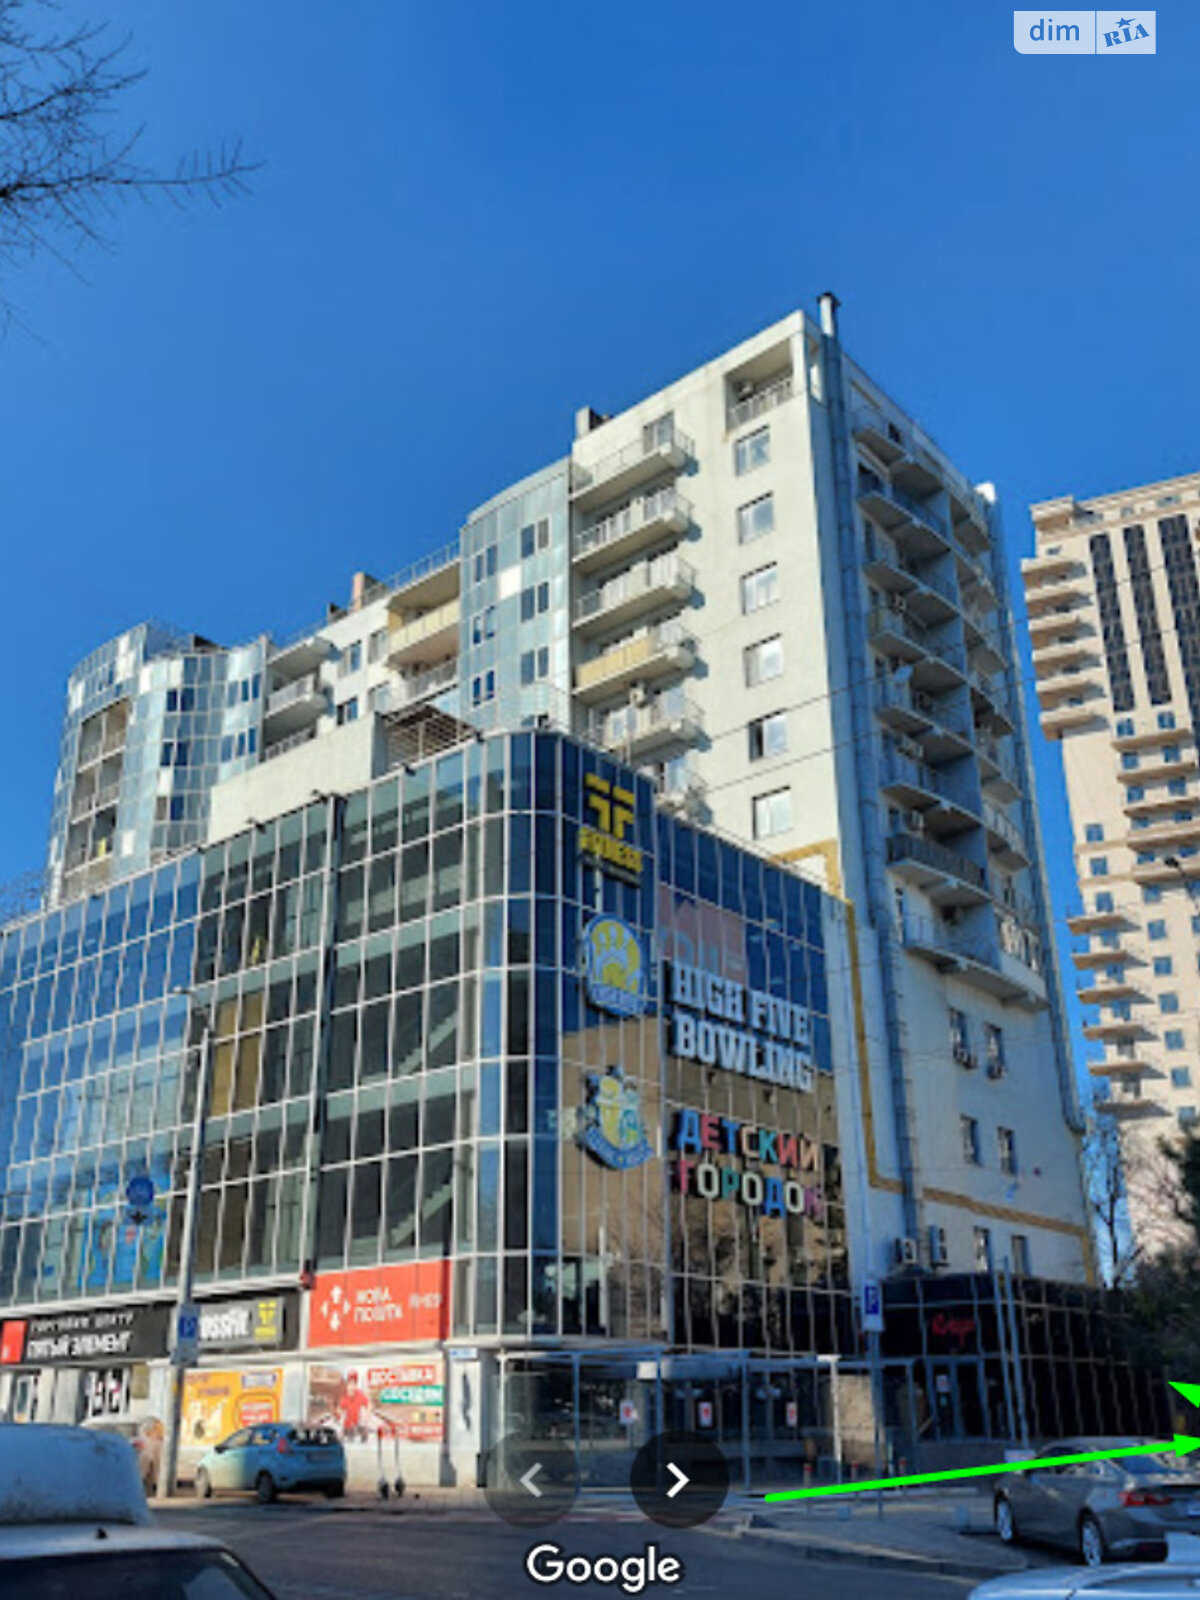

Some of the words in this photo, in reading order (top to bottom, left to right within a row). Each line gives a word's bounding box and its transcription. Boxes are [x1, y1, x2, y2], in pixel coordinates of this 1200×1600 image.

[673, 959, 745, 1023] HIGH
[752, 988, 811, 1047] FIVE
[675, 1011, 814, 1093] BOWLING
